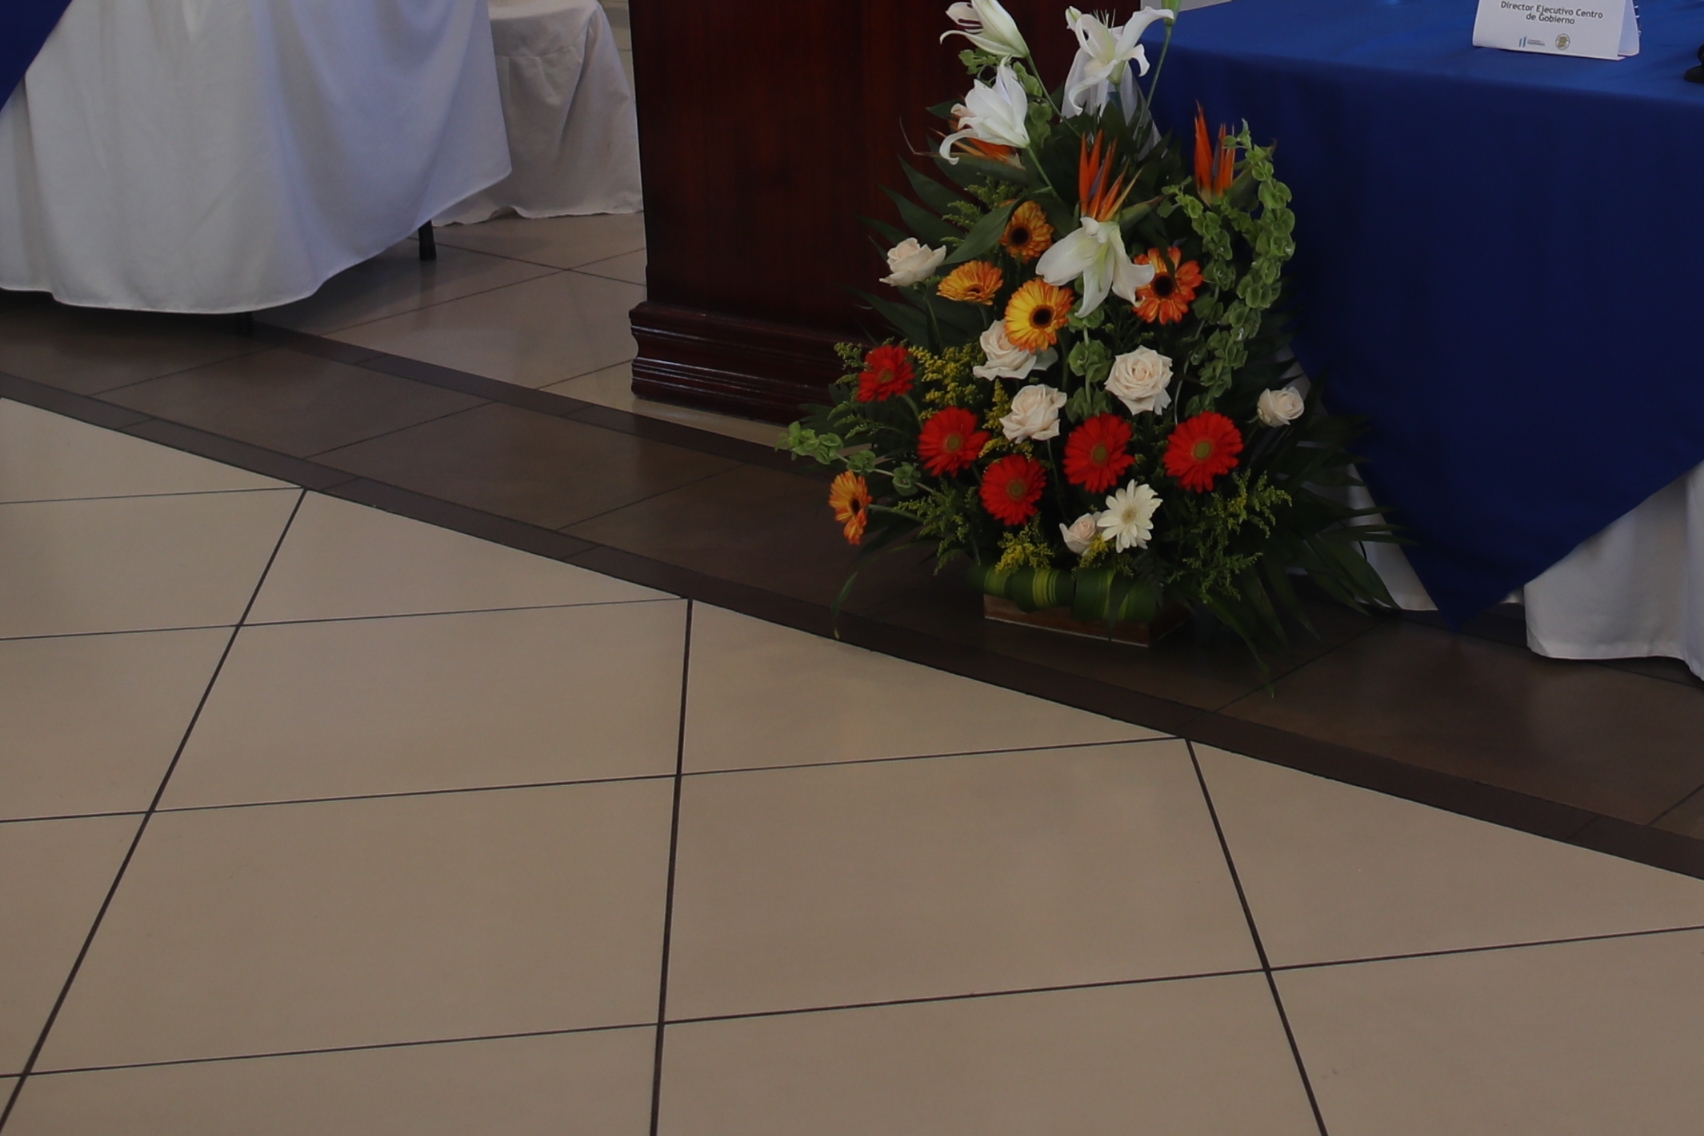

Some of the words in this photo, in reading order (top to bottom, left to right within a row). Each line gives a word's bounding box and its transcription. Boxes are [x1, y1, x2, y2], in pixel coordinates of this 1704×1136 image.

[1500, 0, 1534, 12] Director
[1536, 4, 1574, 17] Ejecutivo
[1576, 8, 1603, 19] Centro
[1526, 13, 1537, 21] de
[1538, 13, 1575, 25] Gobierno
